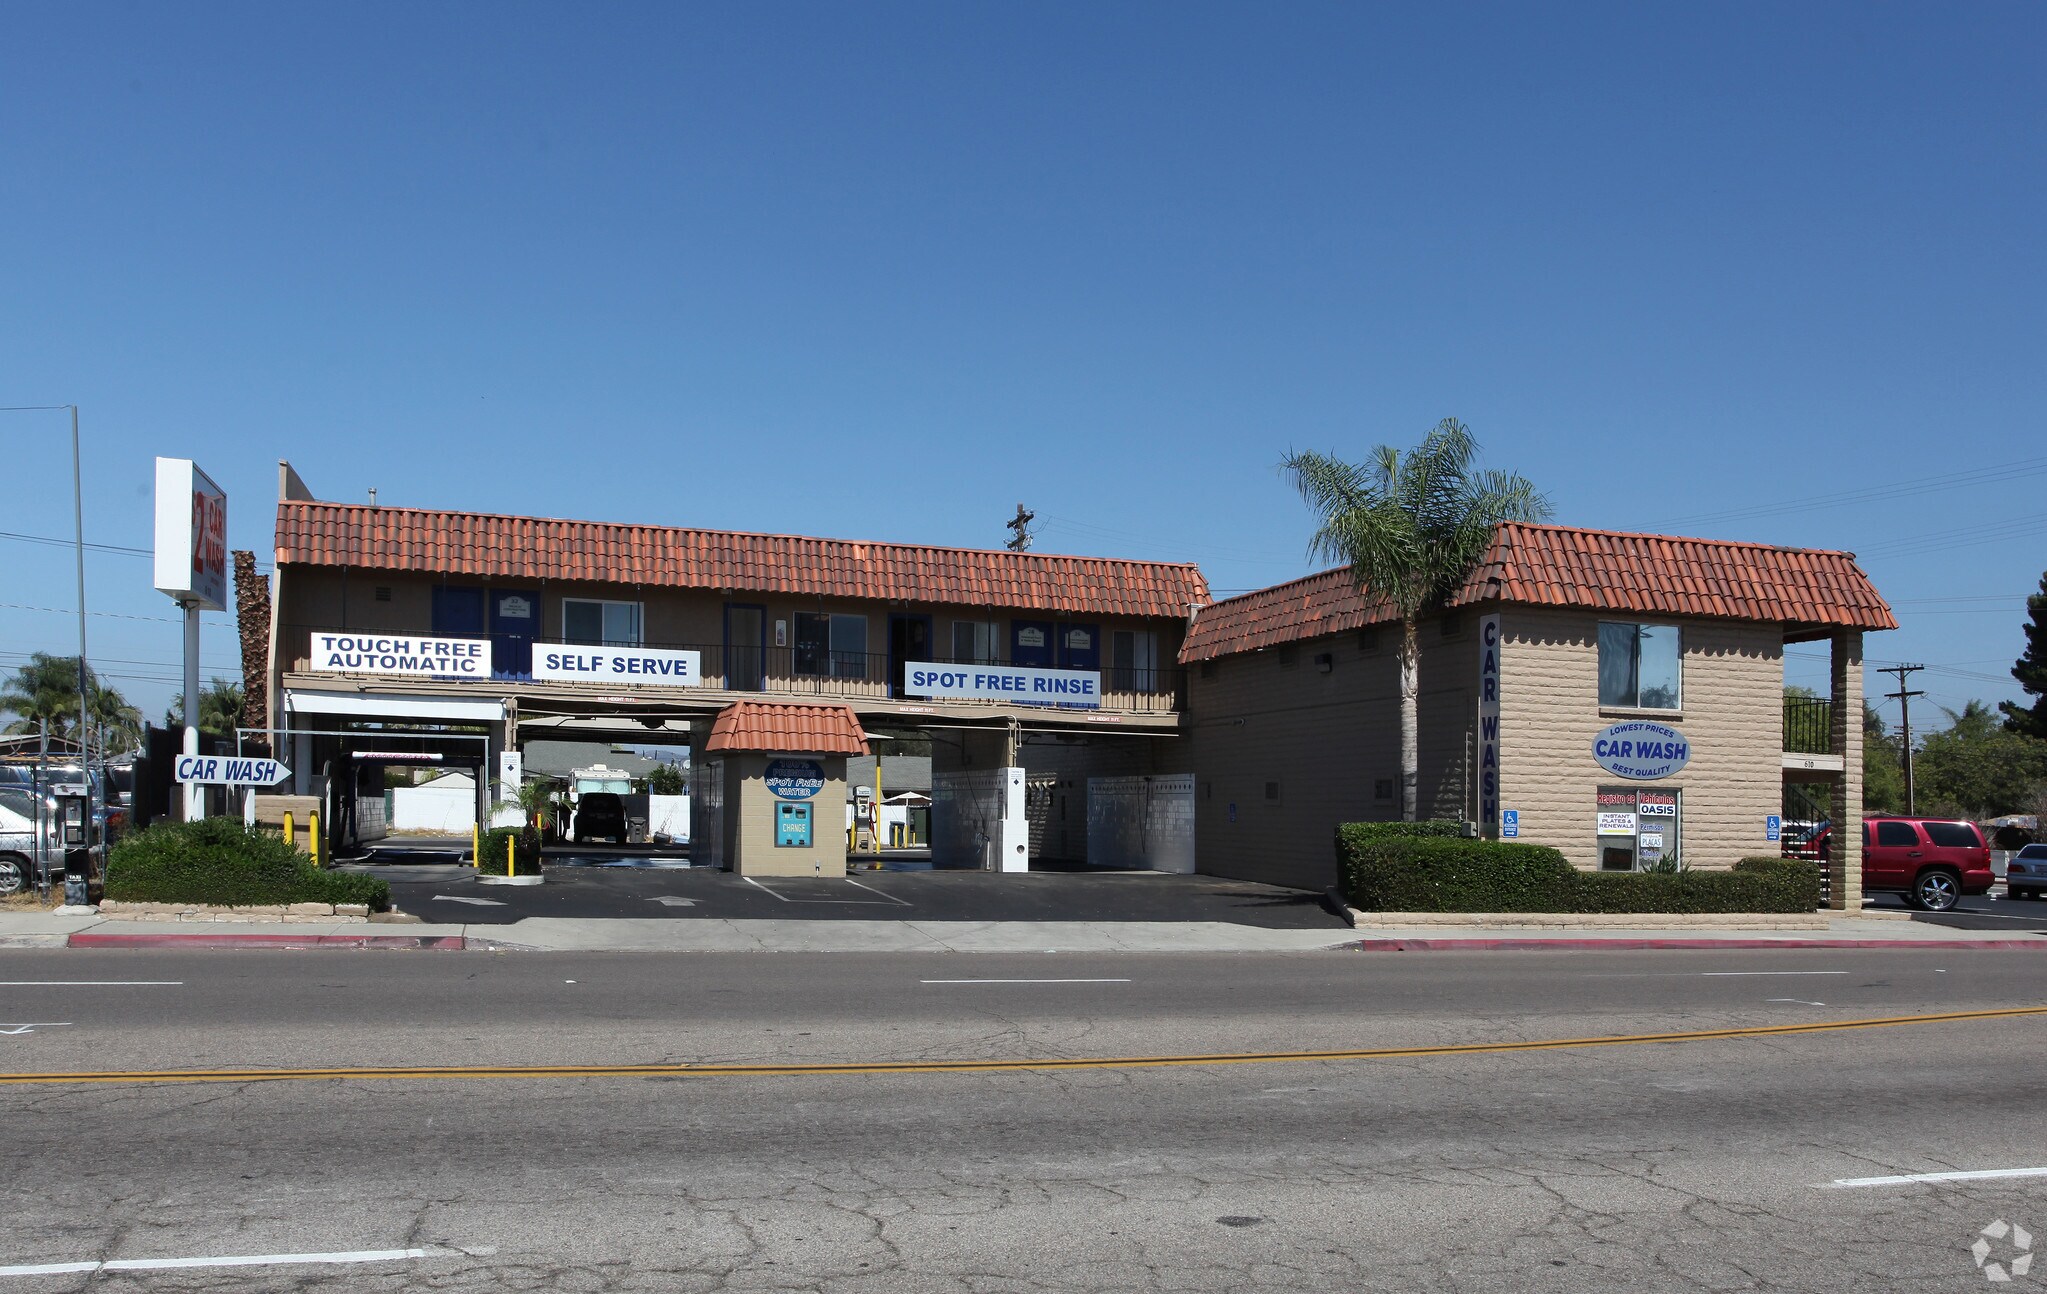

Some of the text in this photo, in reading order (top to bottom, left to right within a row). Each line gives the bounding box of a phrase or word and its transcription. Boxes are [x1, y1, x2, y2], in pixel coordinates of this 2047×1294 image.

[209, 502, 223, 541] CAR
[206, 538, 224, 578] WASH
[321, 637, 482, 657] TOUCH FREE
[328, 653, 476, 672] AUTOMATIC
[546, 654, 687, 676] SELF SERVE
[913, 671, 1094, 695] SPOT FREE RINSE
[1482, 622, 1498, 823] CAR WASH
[1610, 724, 1675, 738] LOWEST PRICES
[1596, 740, 1686, 759] CAR WASH
[179, 758, 277, 781] CAR WASH
[773, 768, 817, 778] PREMIUM
[1612, 763, 1671, 776] BEST QUALITY
[766, 778, 823, 788] SPOT FREE
[778, 788, 811, 797] WATER
[1598, 794, 1625, 806] Registro
[1626, 794, 1636, 804] de
[1641, 805, 1674, 814] OASIS
[783, 824, 806, 832] CHANGE
[1642, 838, 1661, 846] PLACAS
